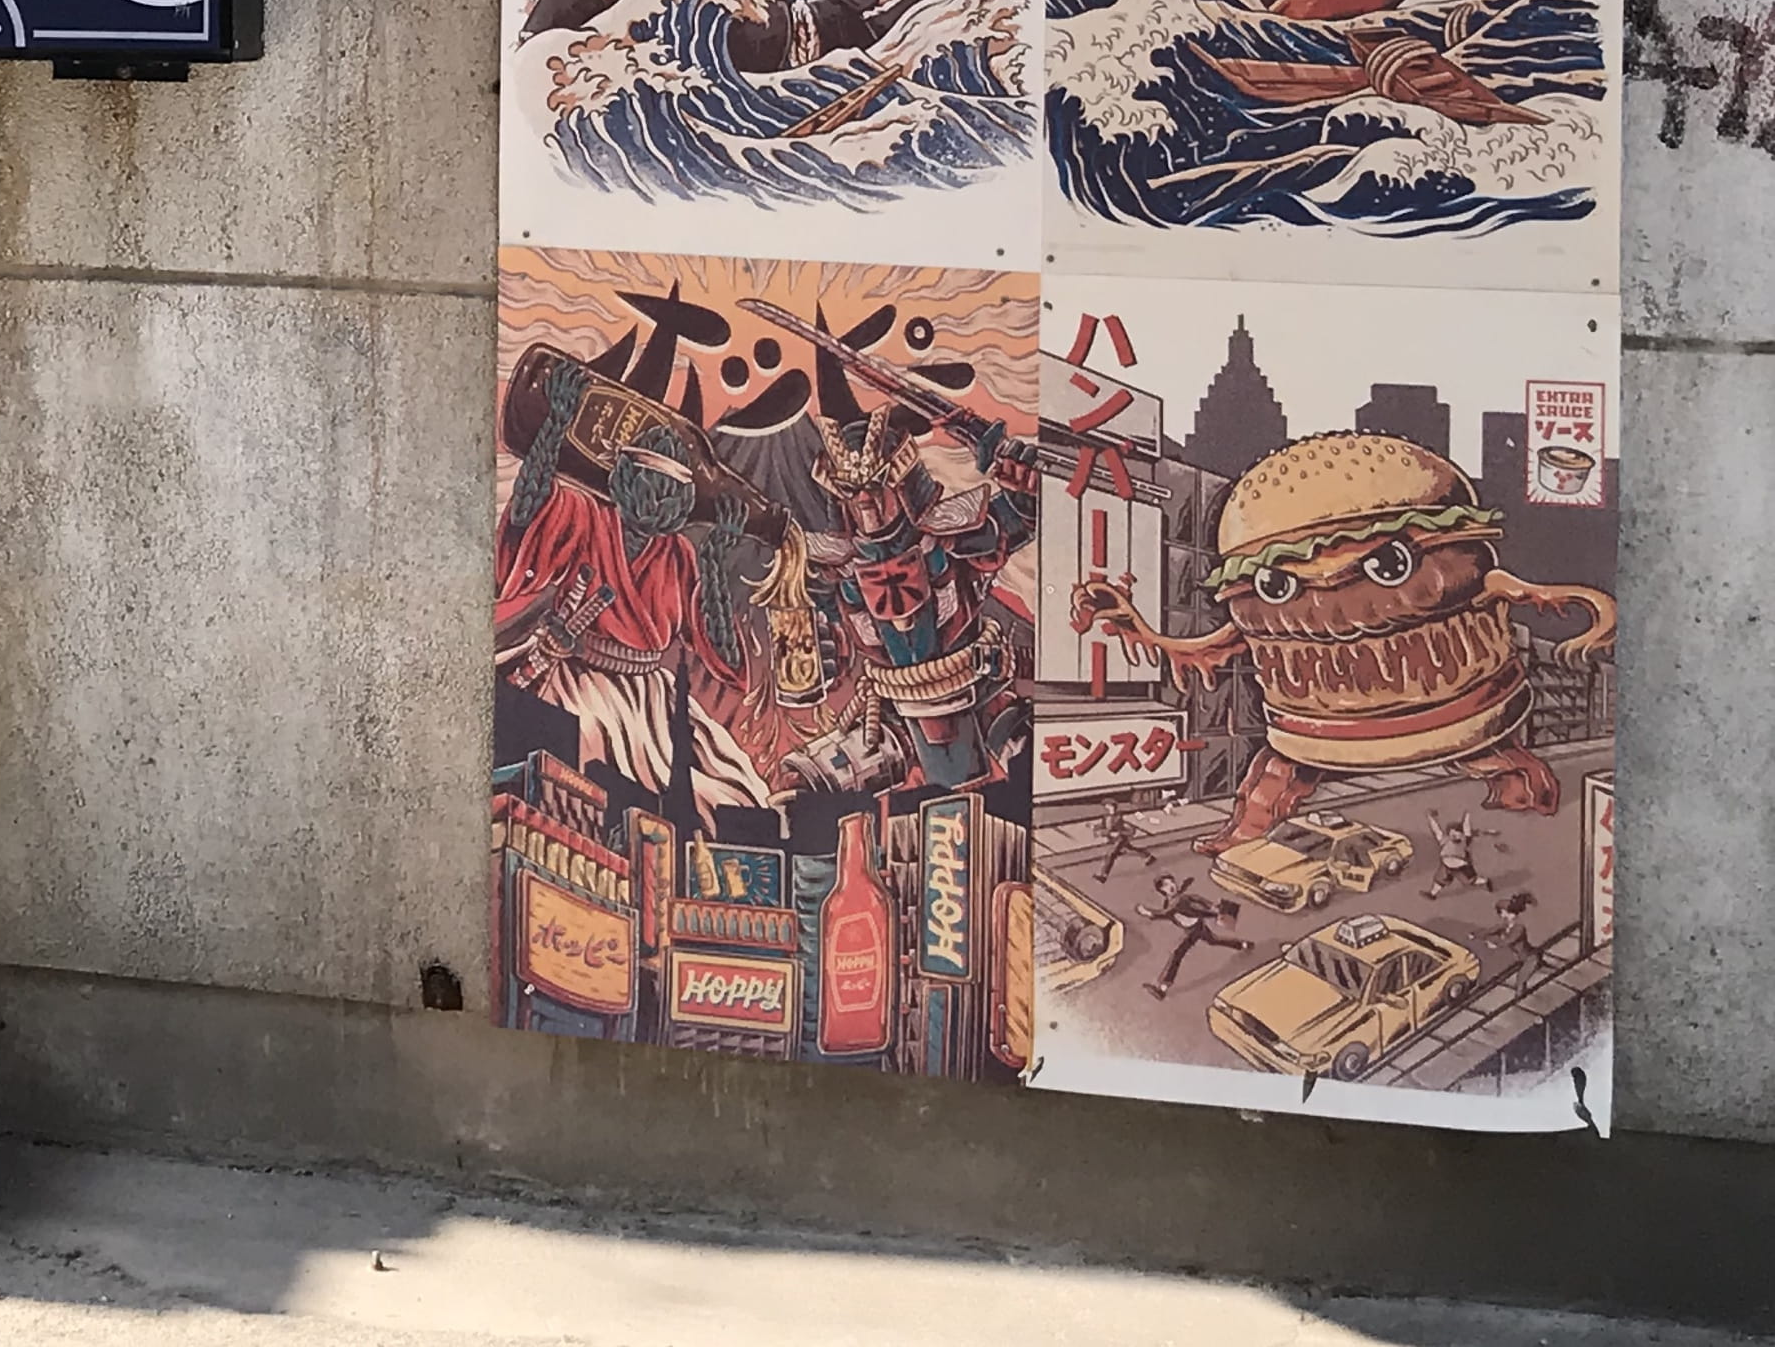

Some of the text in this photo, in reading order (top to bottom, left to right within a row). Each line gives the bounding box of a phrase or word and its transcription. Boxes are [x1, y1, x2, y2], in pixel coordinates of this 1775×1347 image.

[1536, 390, 1594, 405] EXTRA
[1536, 404, 1594, 419] SAUCE
[1535, 420, 1595, 443] ソース
[1040, 725, 1209, 780] モンスター
